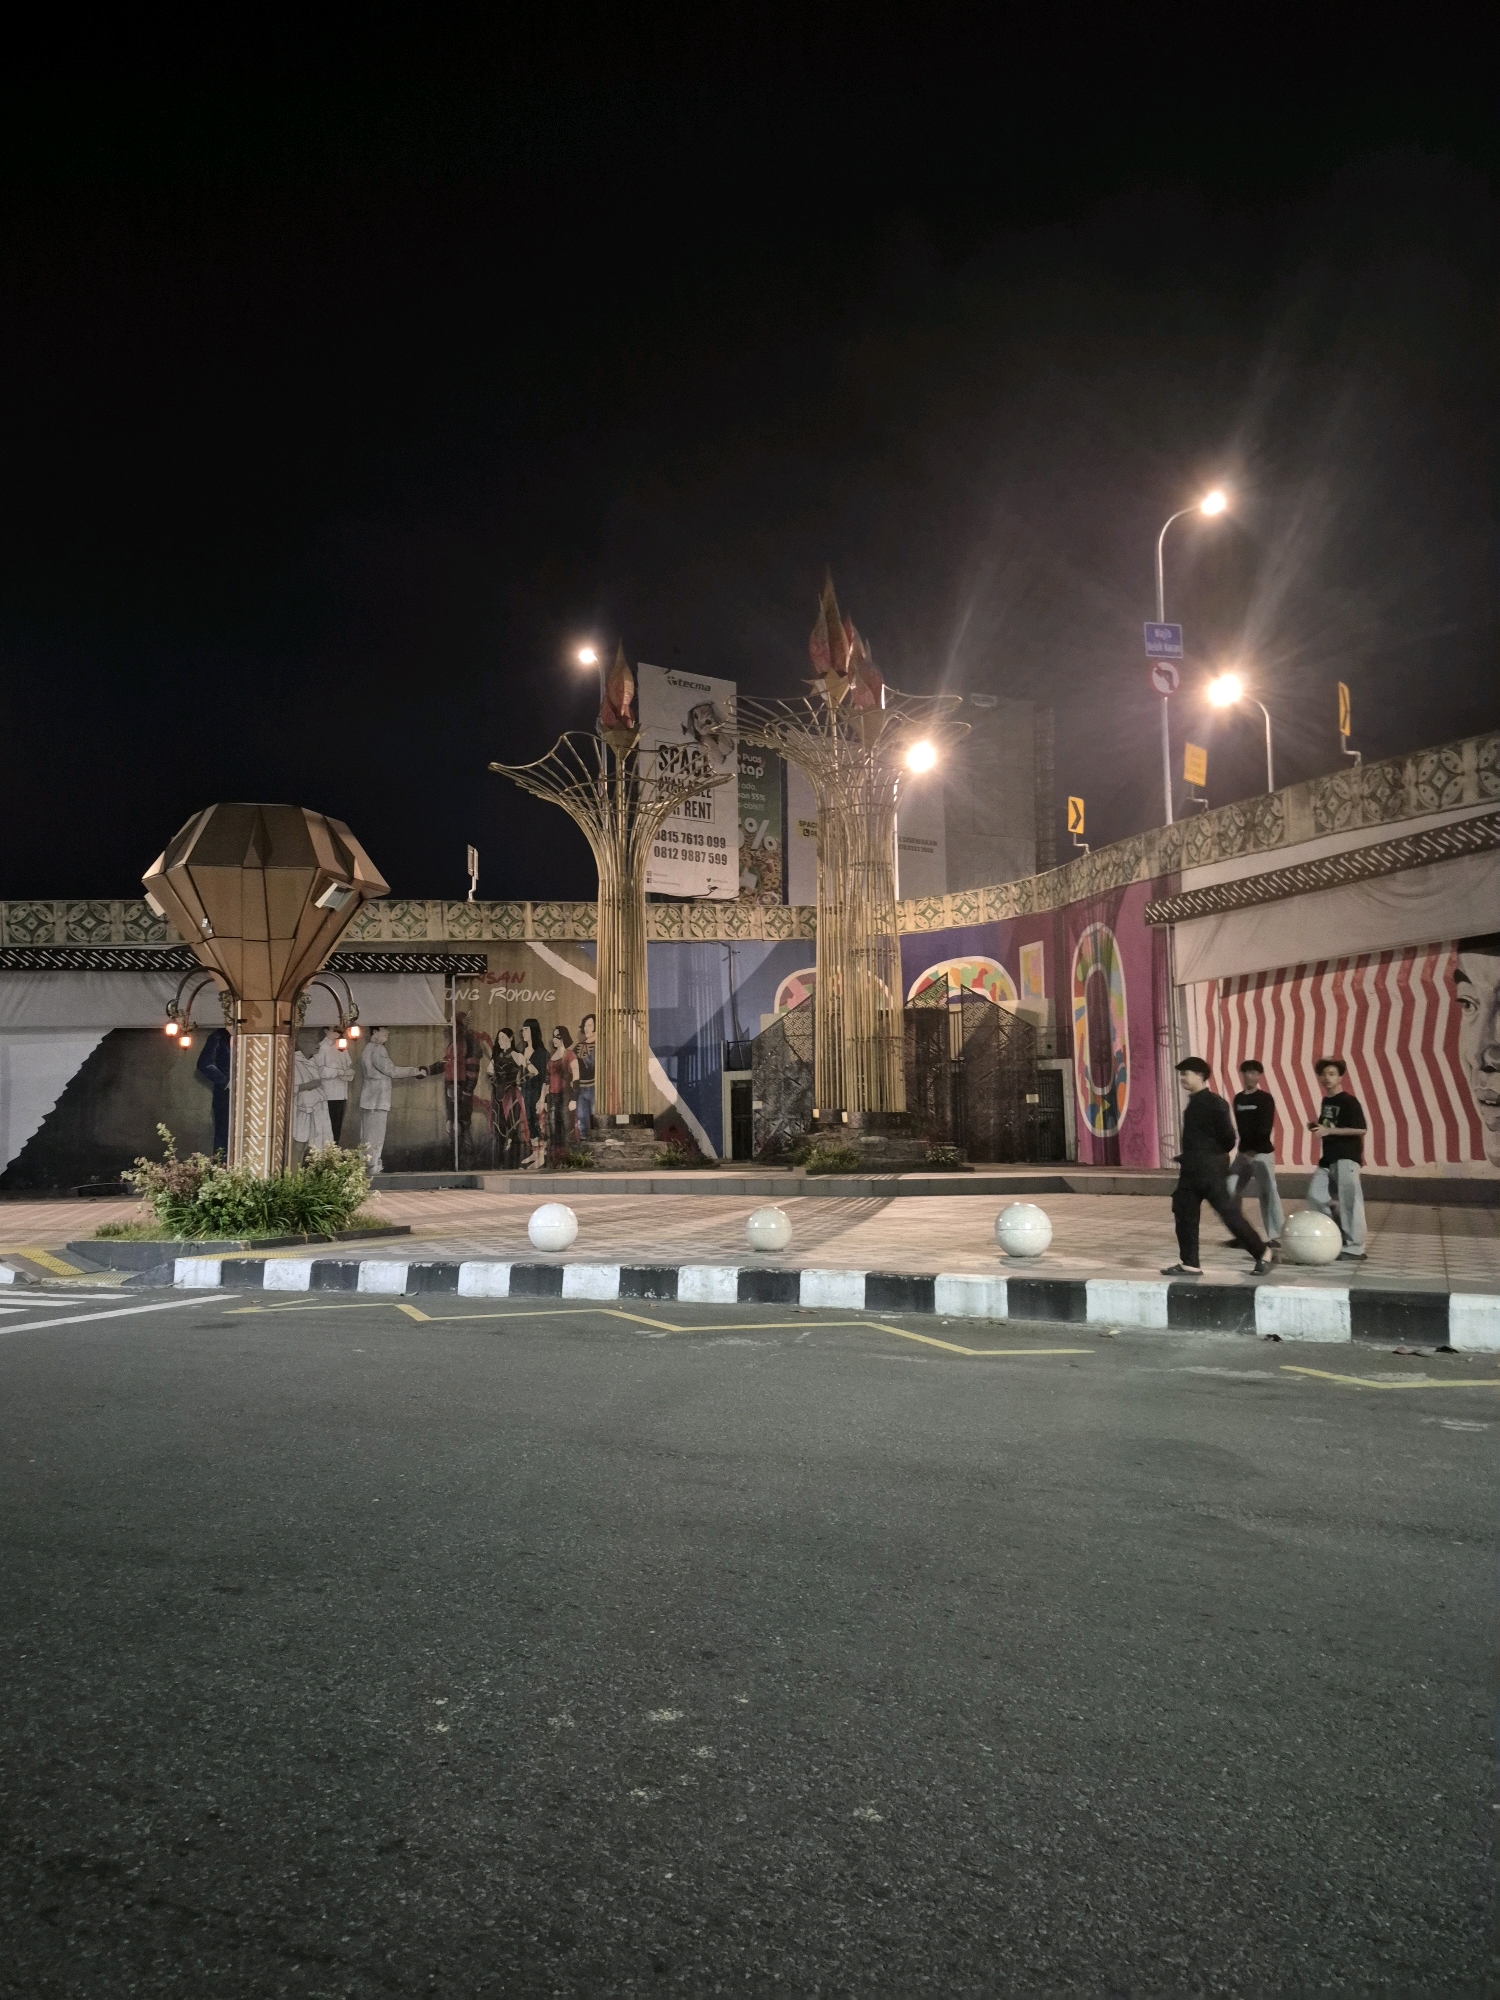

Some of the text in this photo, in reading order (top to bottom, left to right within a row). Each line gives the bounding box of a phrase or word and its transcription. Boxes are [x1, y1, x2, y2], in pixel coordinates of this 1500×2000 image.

[677, 678, 711, 692] tecma
[658, 745, 712, 778] SPACE
[684, 800, 712, 820] RENT
[681, 832, 705, 847] 7613
[706, 835, 727, 849] 099
[654, 845, 728, 866] 0812 9887 599
[488, 986, 556, 1005] ROYONG
